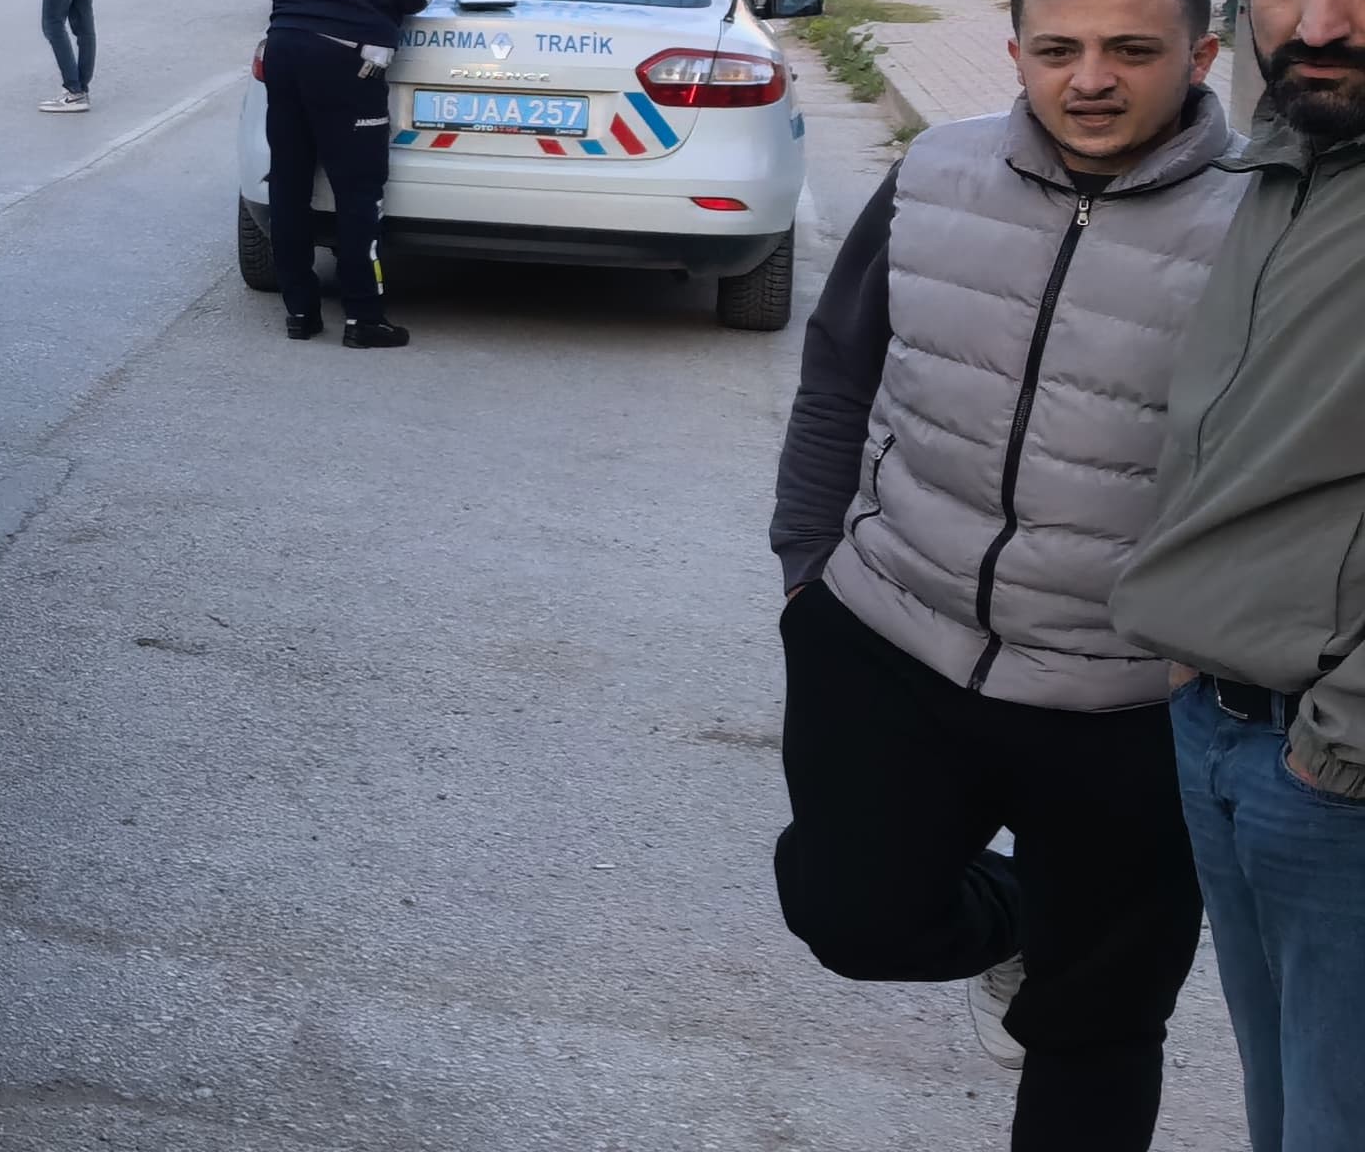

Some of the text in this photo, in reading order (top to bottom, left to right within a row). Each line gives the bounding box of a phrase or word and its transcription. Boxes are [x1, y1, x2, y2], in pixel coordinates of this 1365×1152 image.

[398, 29, 614, 56] NDARMA TRAFİK
[449, 68, 552, 83] FLUENCE
